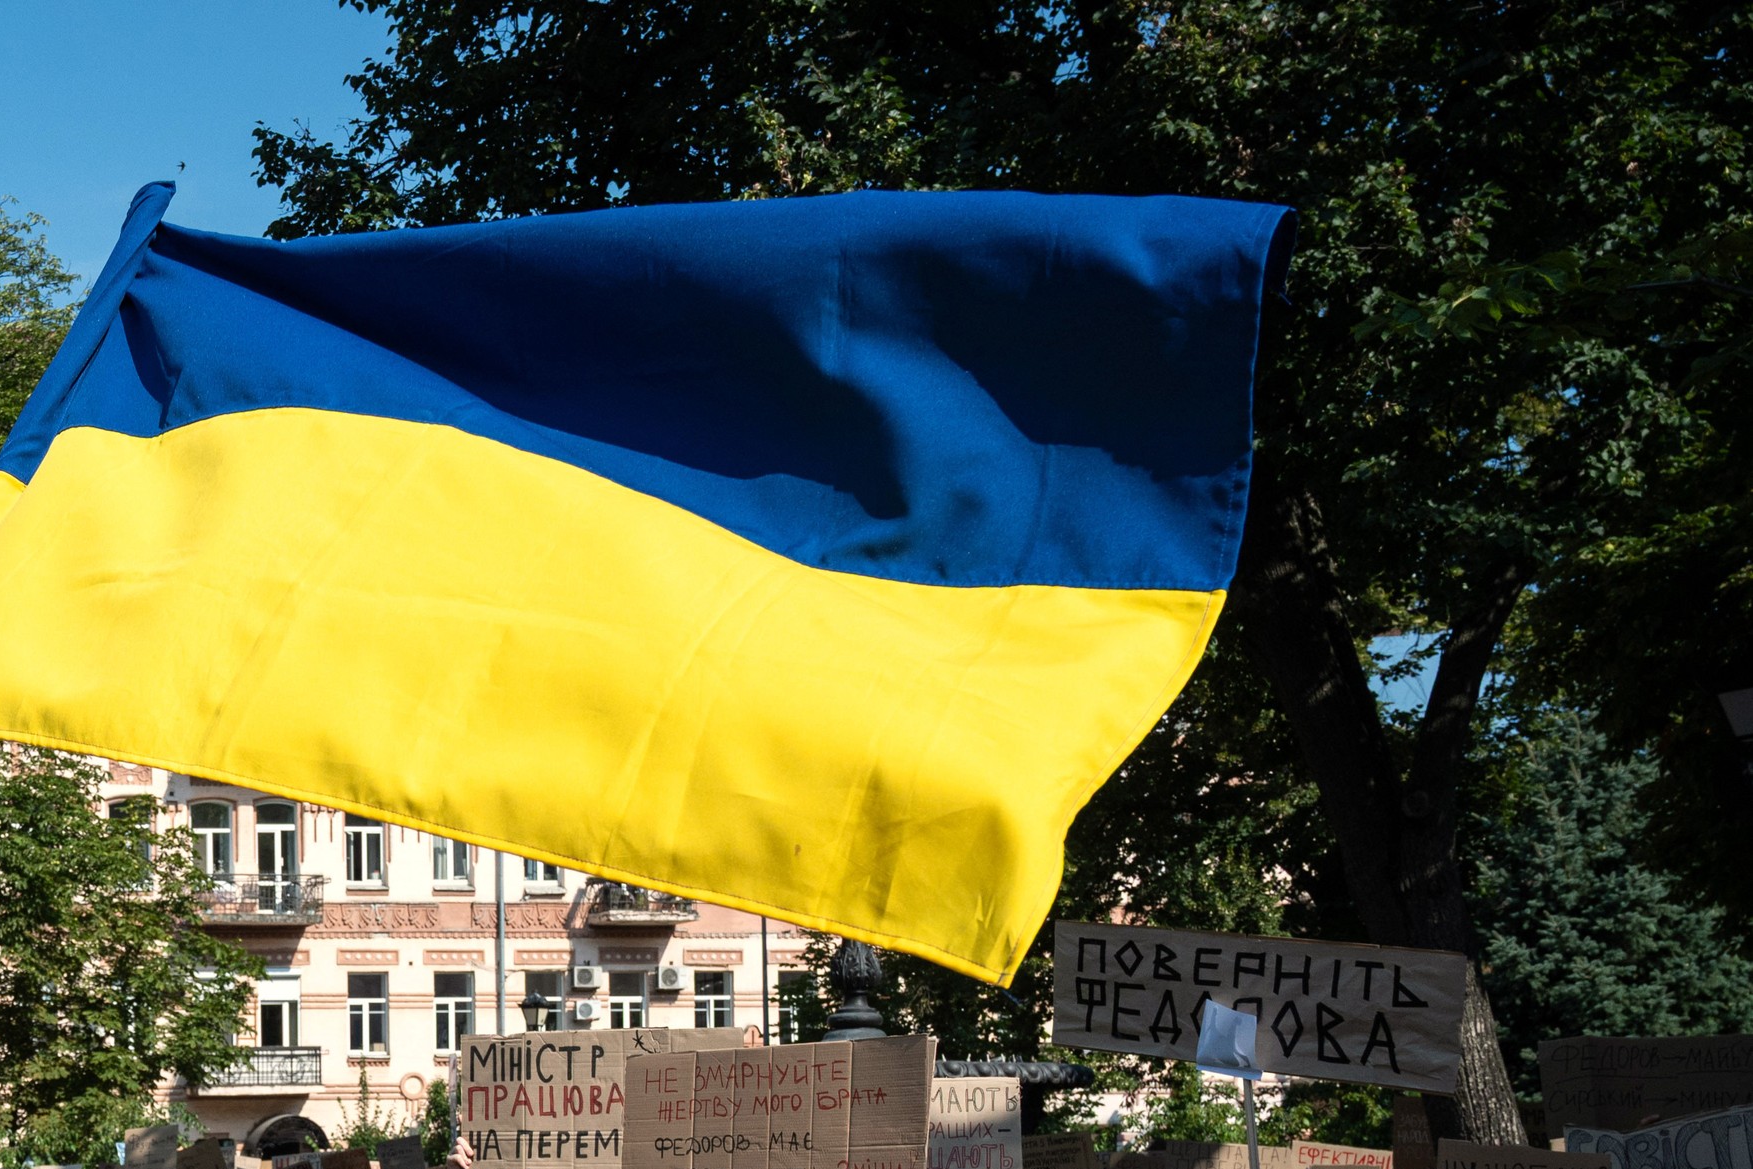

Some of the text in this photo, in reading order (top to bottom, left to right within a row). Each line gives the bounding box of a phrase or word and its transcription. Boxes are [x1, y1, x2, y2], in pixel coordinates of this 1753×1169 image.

[1078, 937, 1429, 1008] ПОВЕРНІТЬ
[470, 1040, 605, 1083] МІНІСТР
[646, 1060, 848, 1093] НЕ ЗМАРНУЙТЕ
[657, 1087, 887, 1123] ЖЕРТВУ МОГО БРАТА
[655, 1133, 751, 1158] ФЕДОРОВ
